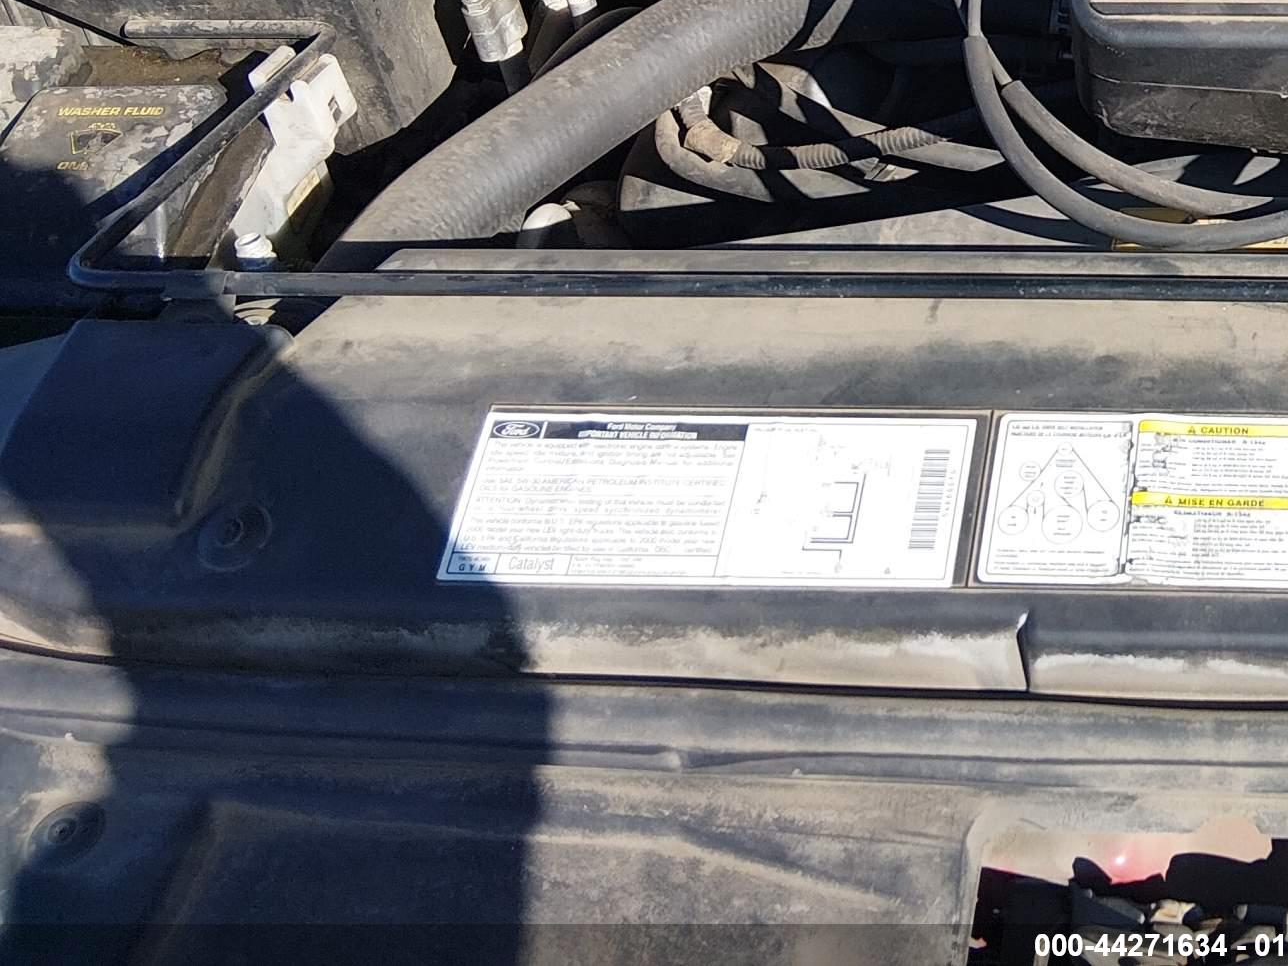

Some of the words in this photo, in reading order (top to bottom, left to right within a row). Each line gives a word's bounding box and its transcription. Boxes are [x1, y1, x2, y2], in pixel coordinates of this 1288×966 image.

[57, 106, 121, 116] WASHER
[123, 106, 165, 116] FLUID
[607, 421, 623, 430] Ford
[619, 431, 648, 439] VEHICLE
[1200, 426, 1249, 435] CAUTION
[1178, 497, 1203, 506] MISE
[1208, 498, 1224, 507] EN
[1227, 498, 1265, 507] GARDE
[508, 555, 555, 573] Catalyst
